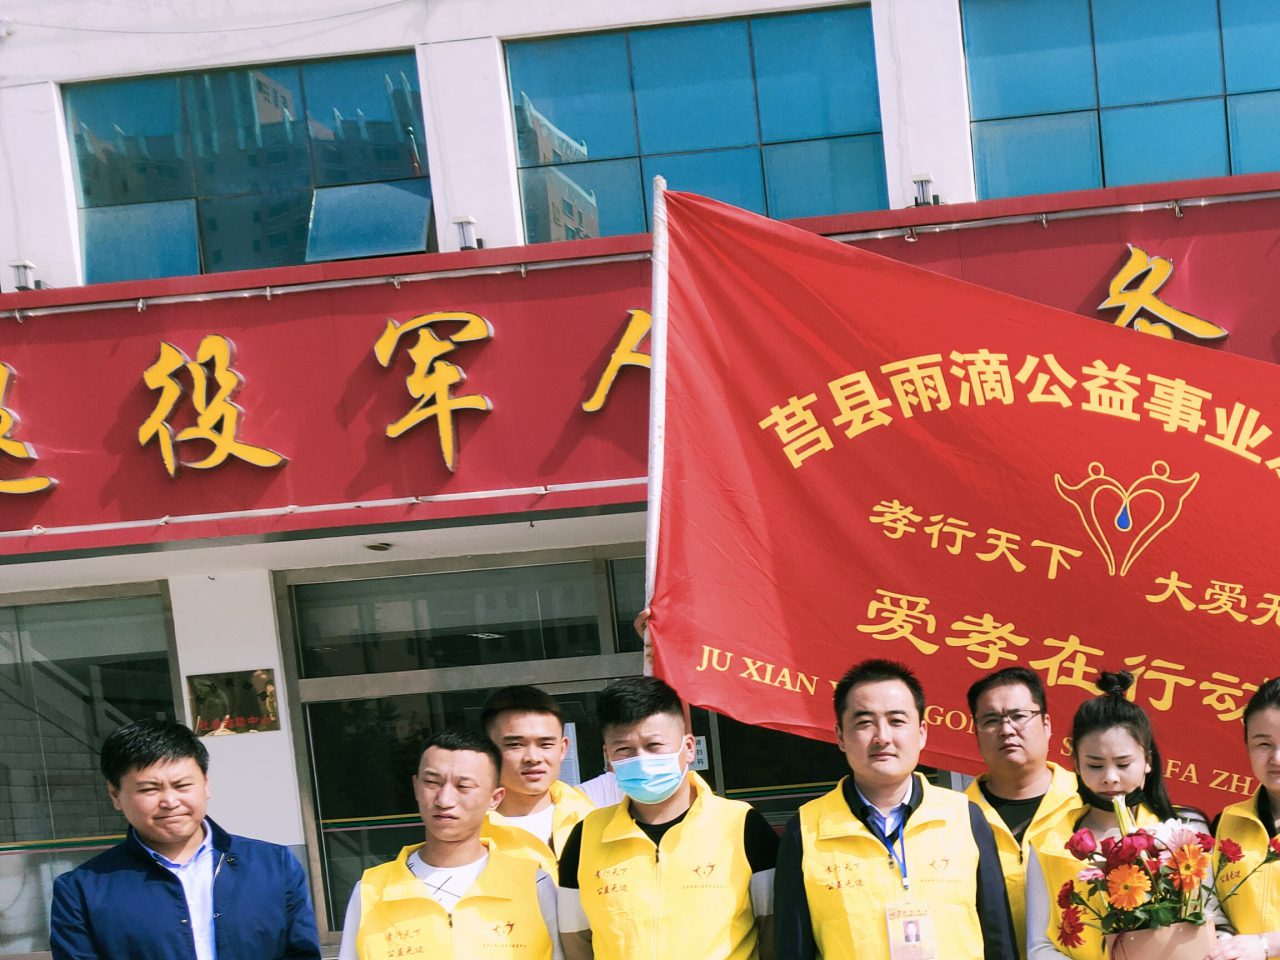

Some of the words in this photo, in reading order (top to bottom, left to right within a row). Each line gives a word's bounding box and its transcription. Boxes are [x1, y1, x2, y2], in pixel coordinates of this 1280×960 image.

[869, 499, 1083, 580] 孝行天下
[696, 645, 734, 672] JU
[739, 656, 820, 696] XIAN
[1163, 758, 1201, 785] FA
